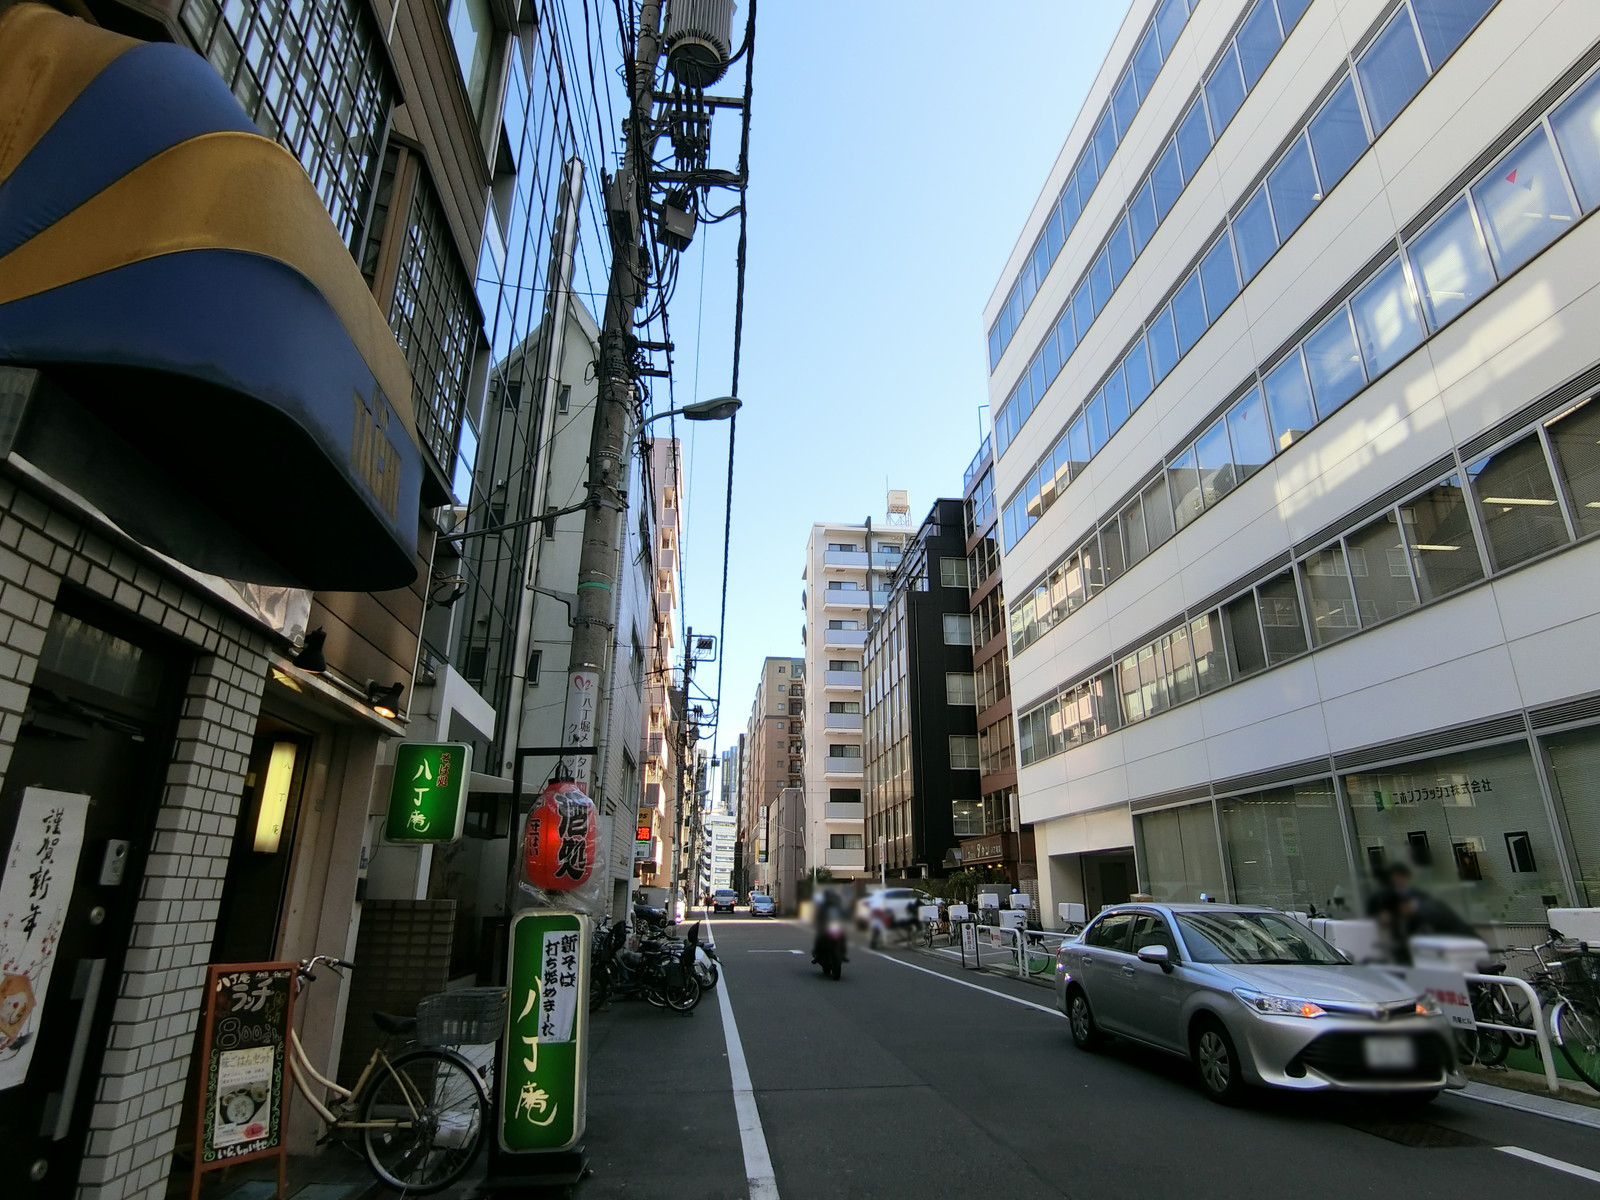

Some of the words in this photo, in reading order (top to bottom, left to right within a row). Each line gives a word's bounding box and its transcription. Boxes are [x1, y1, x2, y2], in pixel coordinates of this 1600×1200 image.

[566, 723, 578, 778] クリッ
[576, 697, 592, 780] 八丁堀メタル
[406, 758, 433, 833] 八丁庵
[436, 752, 452, 787] そば処
[1392, 777, 1493, 805] ニホンフラッシュ株式会社
[554, 792, 588, 881] 酒処
[637, 827, 650, 840] 満
[20, 807, 64, 941] 謹賀新年
[216, 971, 250, 992] 八丁庵
[560, 934, 578, 988] 新そば
